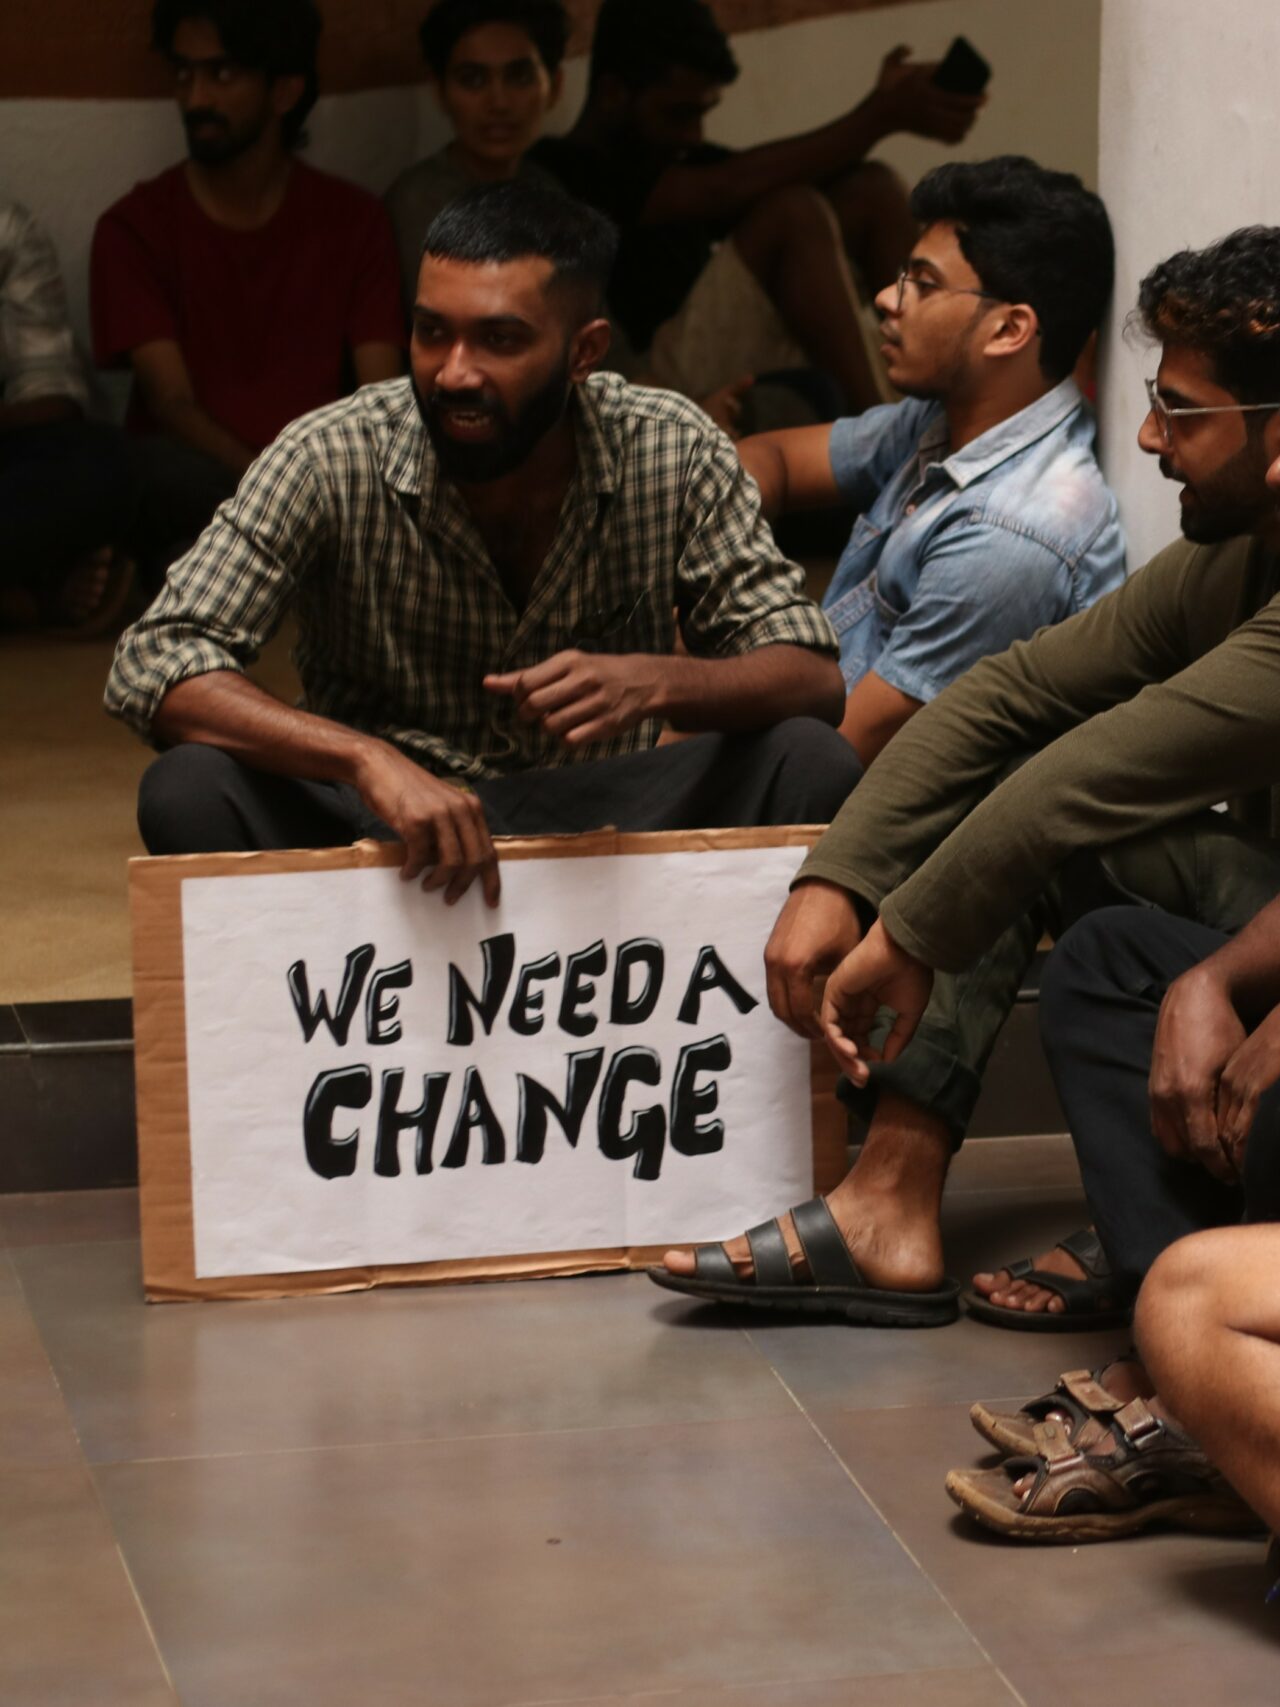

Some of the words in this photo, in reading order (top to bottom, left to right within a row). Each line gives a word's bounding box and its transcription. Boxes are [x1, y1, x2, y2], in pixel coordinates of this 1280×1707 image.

[287, 943, 413, 1047] WE
[446, 932, 665, 1047] NEED
[676, 945, 760, 1026] A
[302, 1033, 732, 1181] CHANGE
